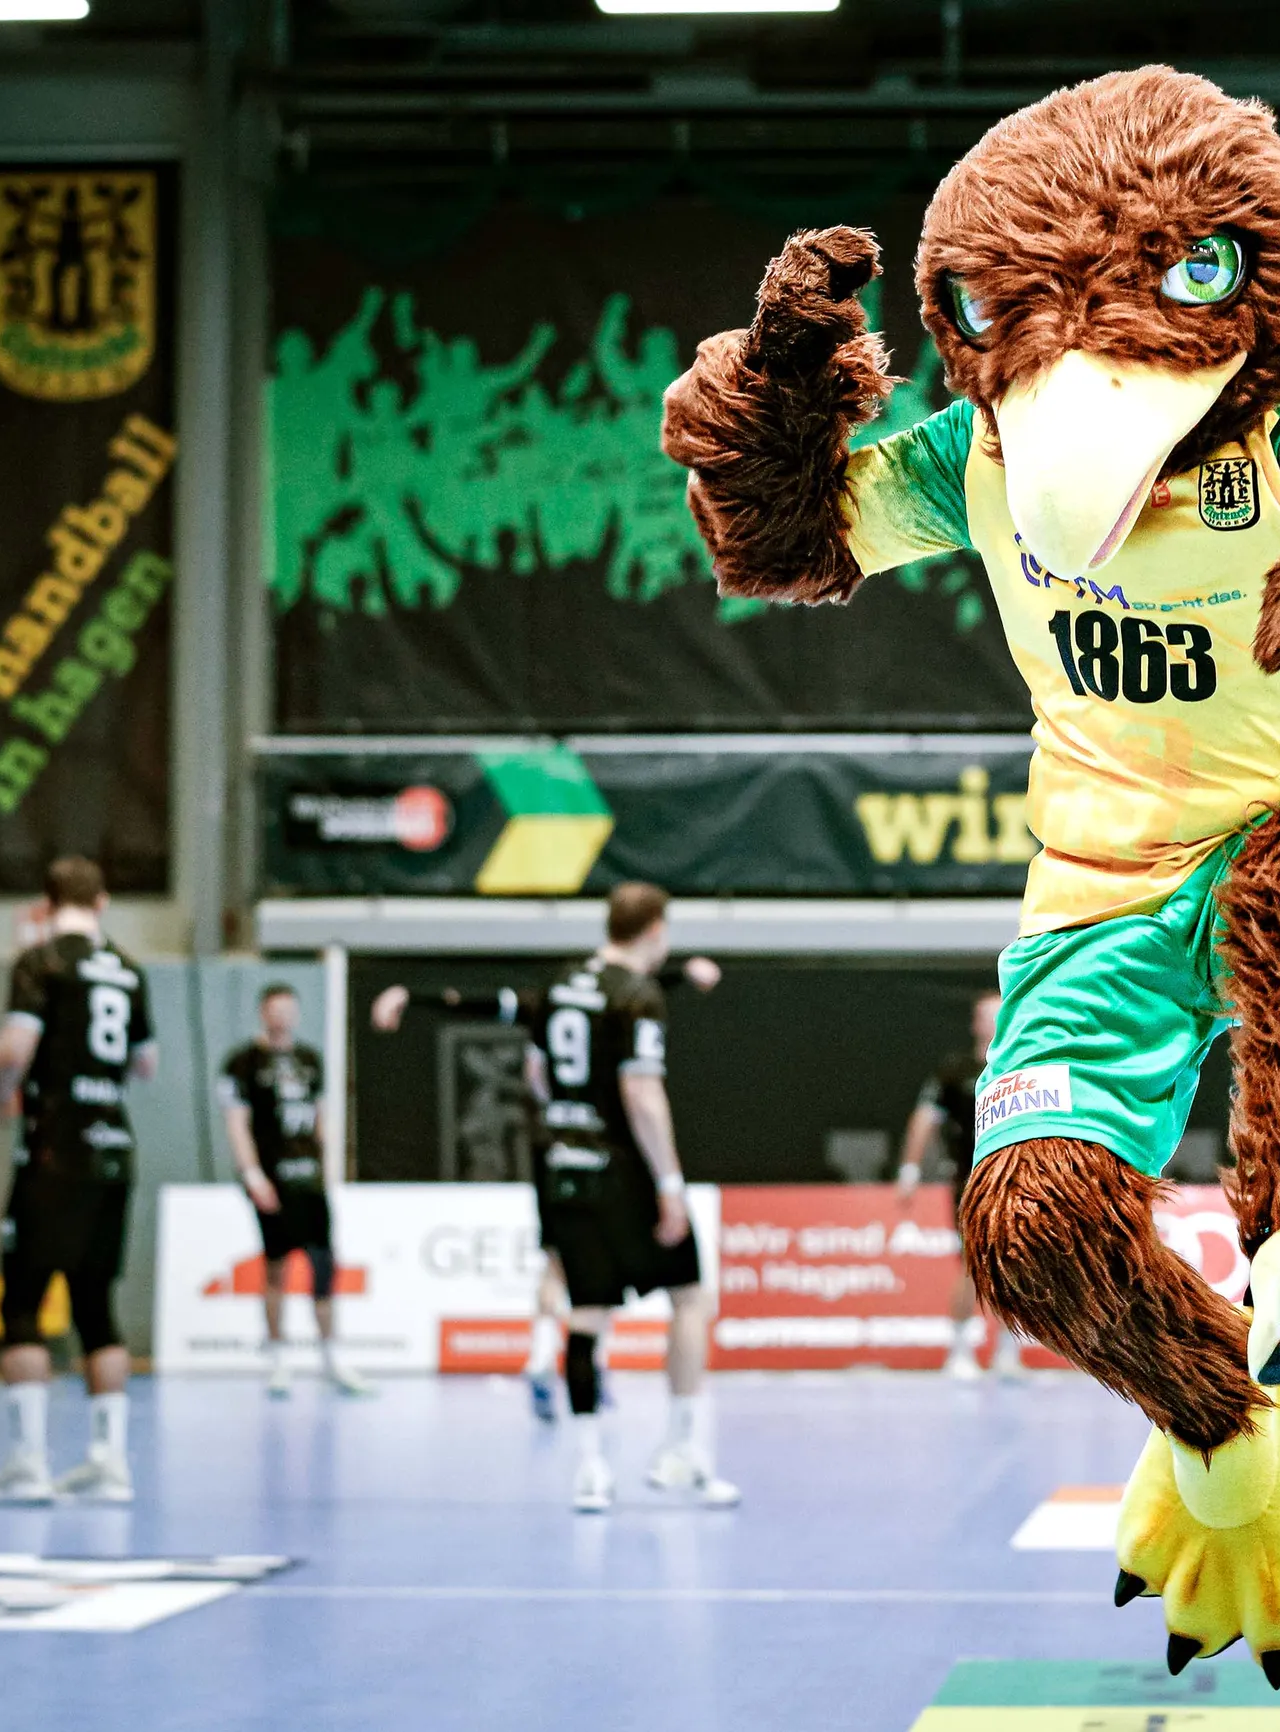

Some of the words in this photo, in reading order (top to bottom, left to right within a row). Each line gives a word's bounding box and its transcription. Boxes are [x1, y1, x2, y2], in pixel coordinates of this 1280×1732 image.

[1208, 516, 1250, 527] HAGEN
[1207, 590, 1247, 605] das.
[11, 549, 174, 747] hagen
[1048, 609, 1217, 704] 1863
[87, 984, 130, 1065] 8
[546, 1007, 591, 1087] 9
